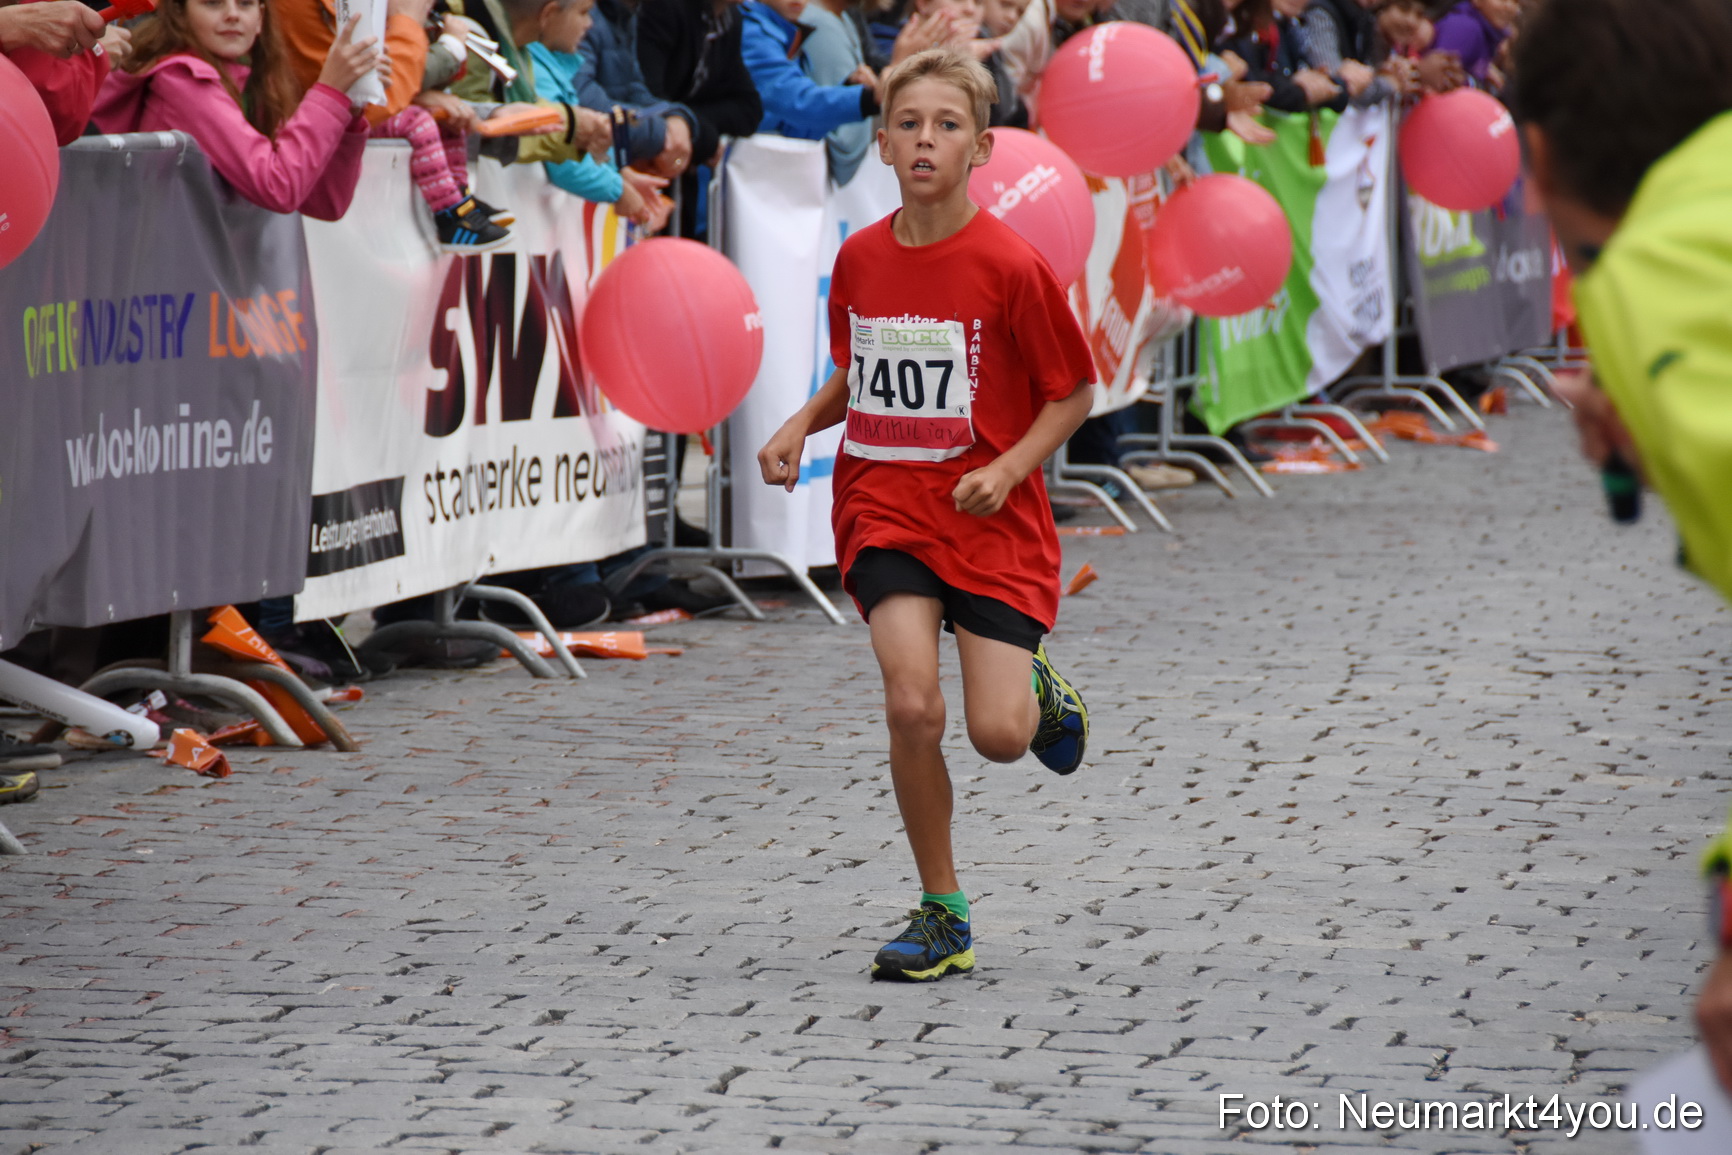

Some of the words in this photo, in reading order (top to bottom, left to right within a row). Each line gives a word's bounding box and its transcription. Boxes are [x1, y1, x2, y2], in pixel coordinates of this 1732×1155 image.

[881, 328, 951, 345] BOCK
[968, 319, 982, 401] BAMBINI
[854, 353, 954, 410] 7407
